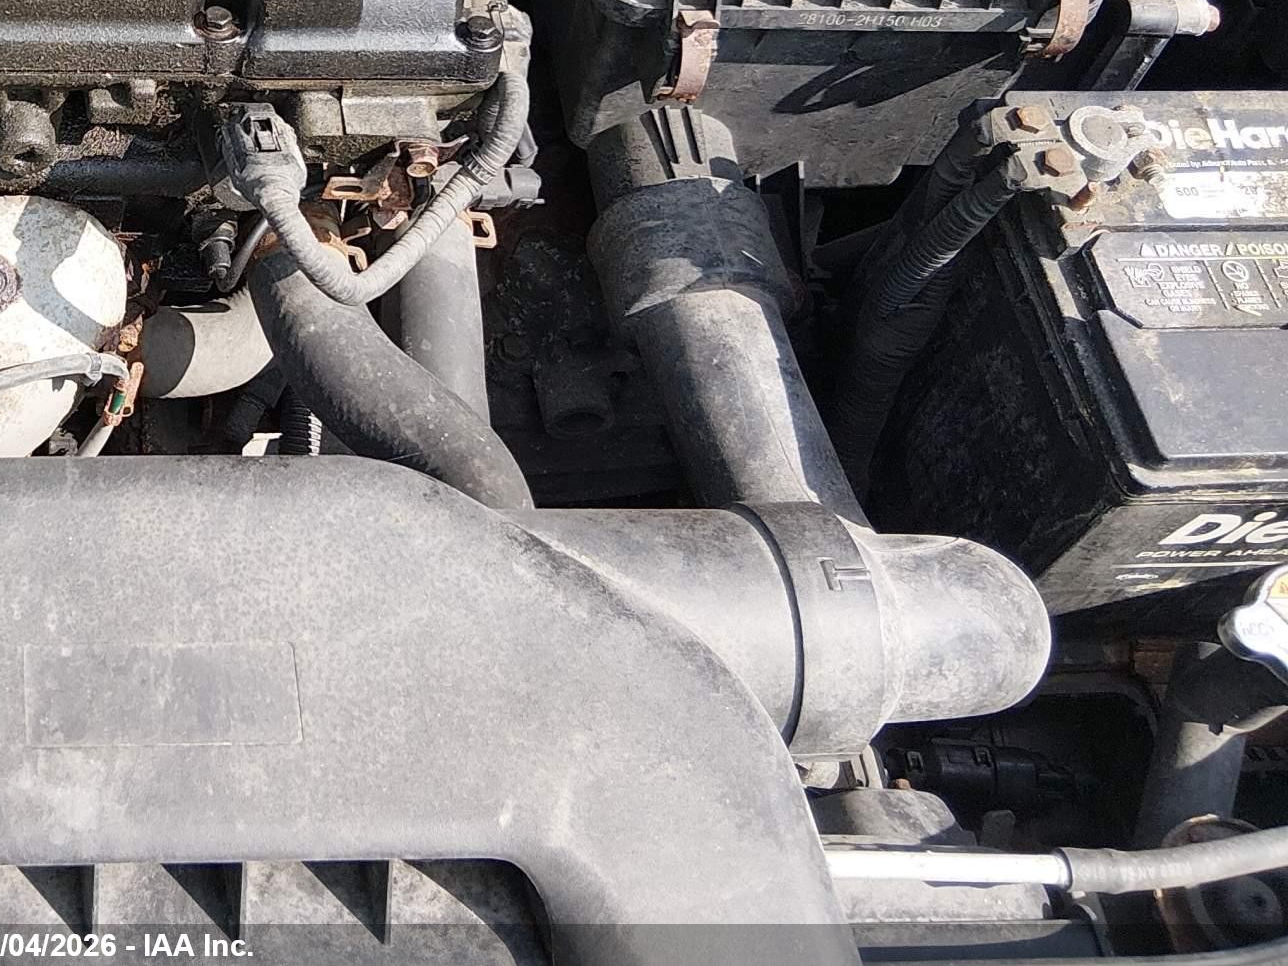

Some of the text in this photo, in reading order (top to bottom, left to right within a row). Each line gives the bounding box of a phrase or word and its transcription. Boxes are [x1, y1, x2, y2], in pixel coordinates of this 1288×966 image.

[1144, 118, 1288, 150] DieHar
[1156, 243, 1224, 257] DANGER
[1158, 511, 1288, 545] Die
[1135, 549, 1223, 559] POWER
